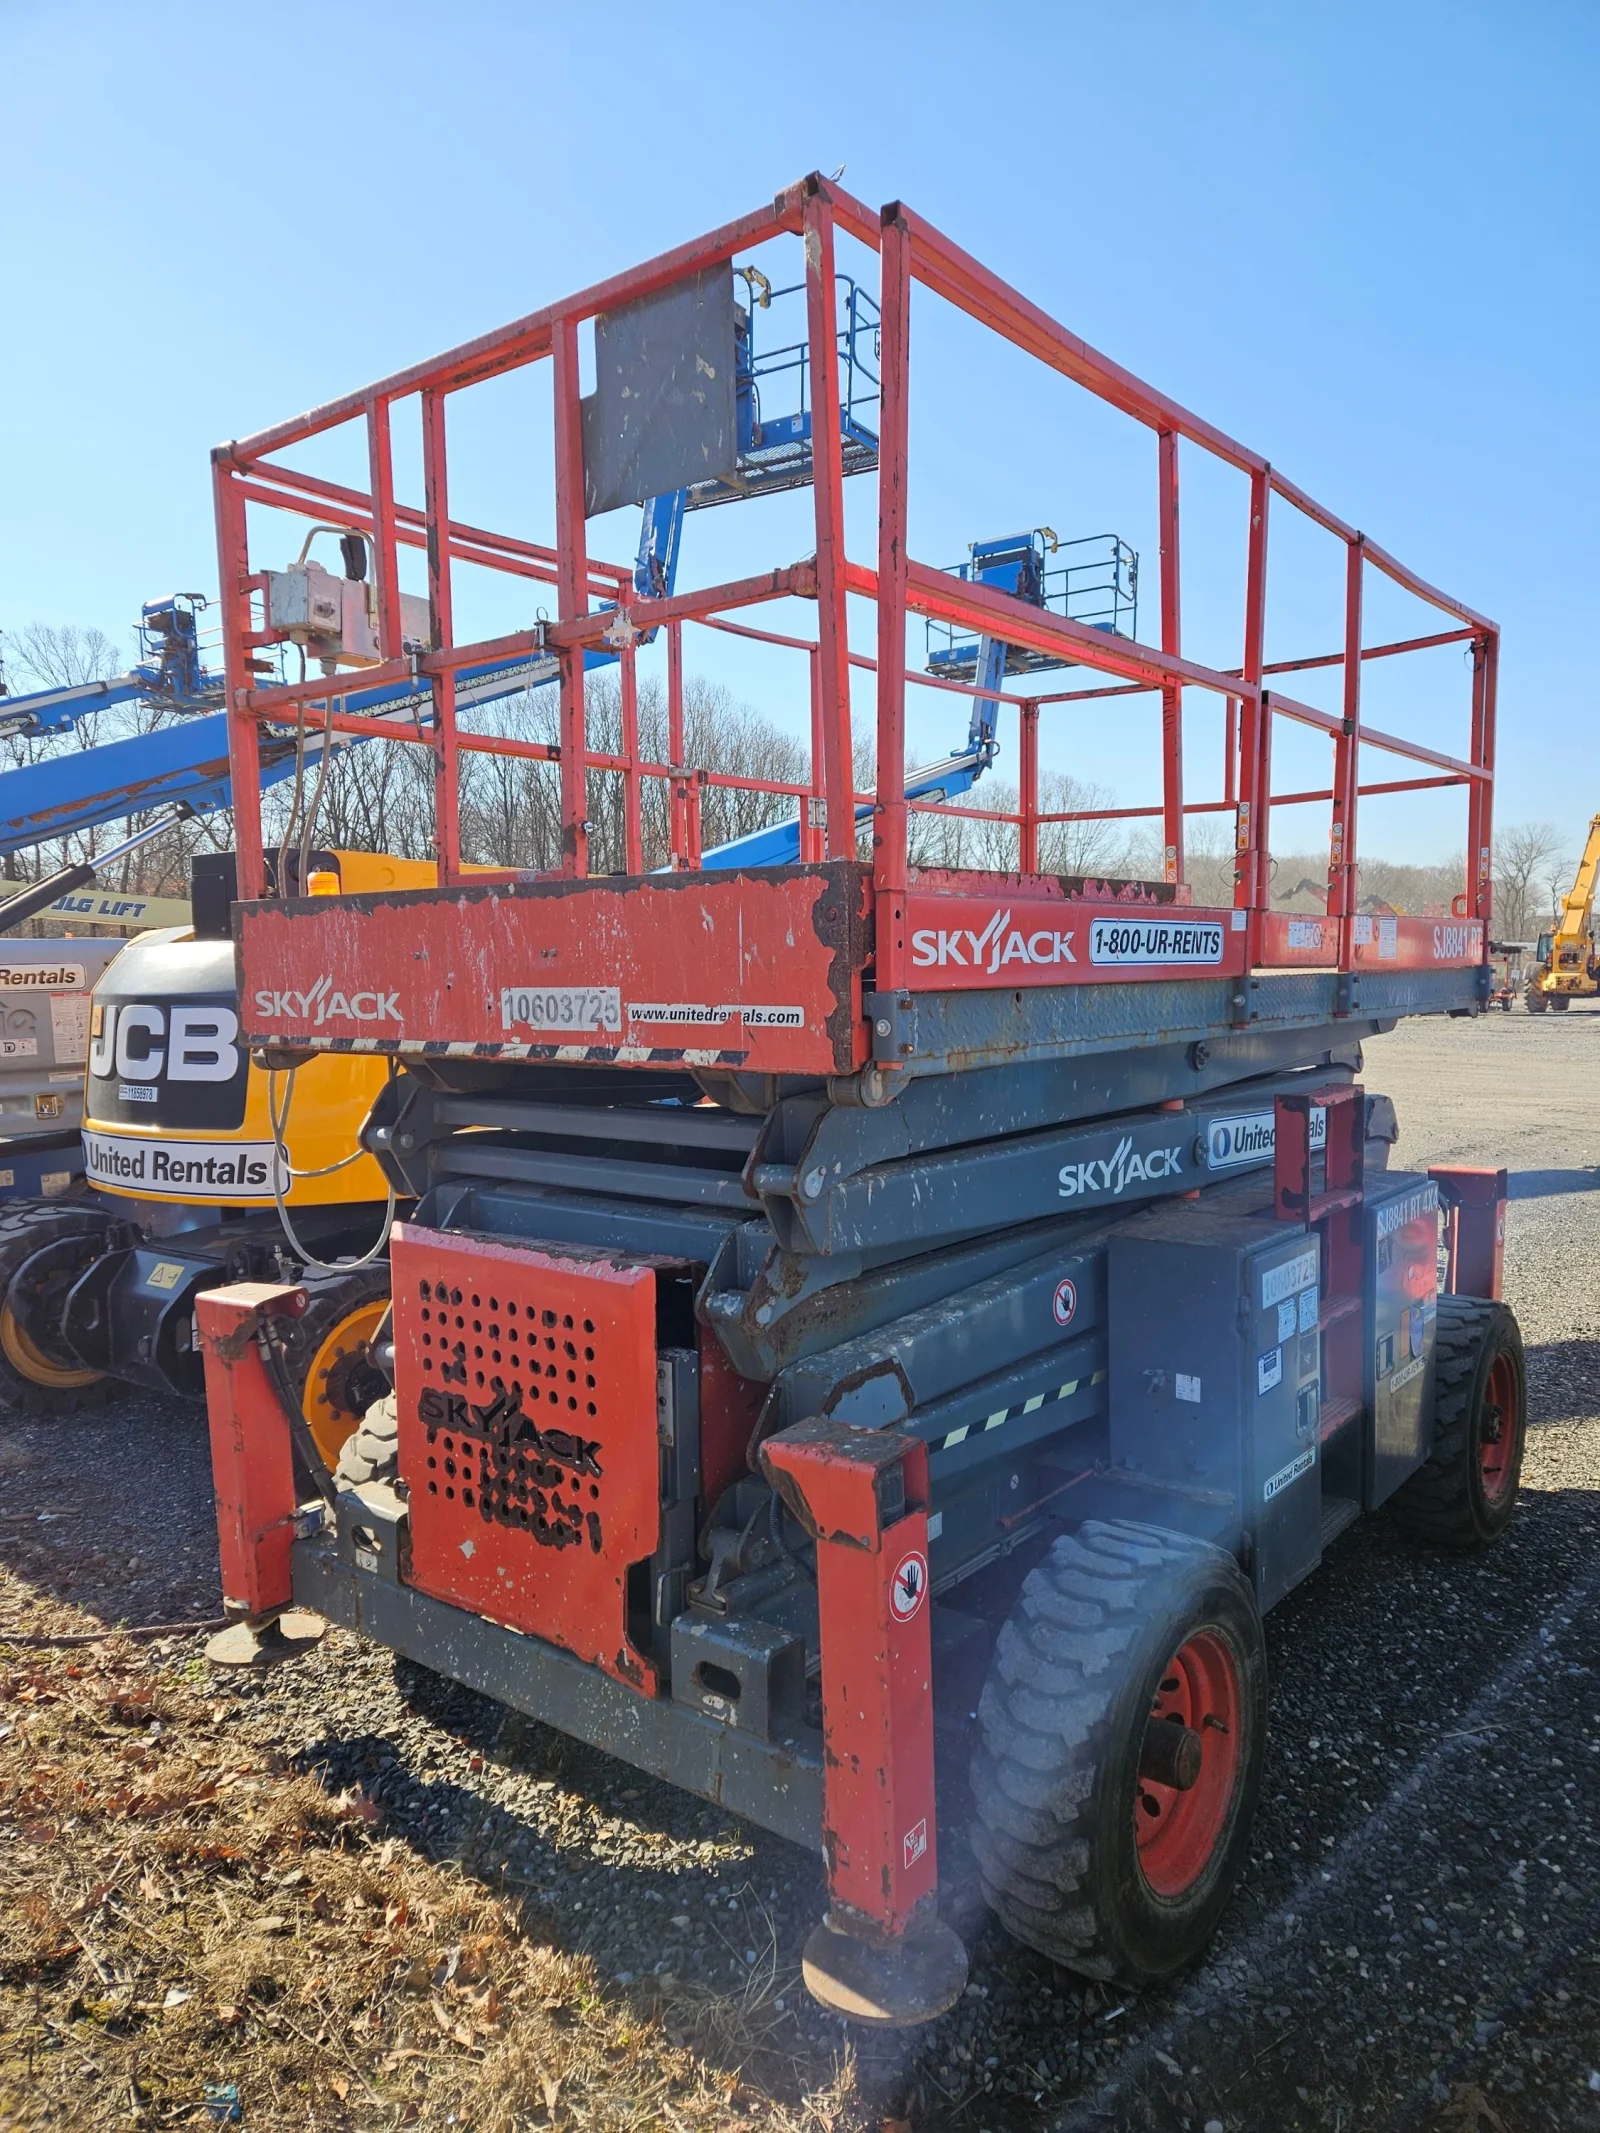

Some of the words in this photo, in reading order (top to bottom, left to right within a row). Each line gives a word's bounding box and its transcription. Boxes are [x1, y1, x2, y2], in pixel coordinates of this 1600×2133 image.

[51, 896, 95, 913] JLG
[97, 900, 147, 917] LIFT
[911, 908, 1078, 975] SKYJACK
[1095, 927, 1220, 956] 1-800-UR-RENTS
[1433, 925, 1468, 960] SJ8841
[254, 974, 404, 1025] SKYJACK
[504, 993, 619, 1024] 10603725
[631, 1006, 800, 1024] www.unitedreals.com
[90, 1004, 239, 1082] JCB
[89, 1141, 145, 1180] United
[152, 1150, 268, 1185] Rentals
[1058, 1136, 1183, 1196] SKYJACK
[1377, 1200, 1408, 1238] SJ8841
